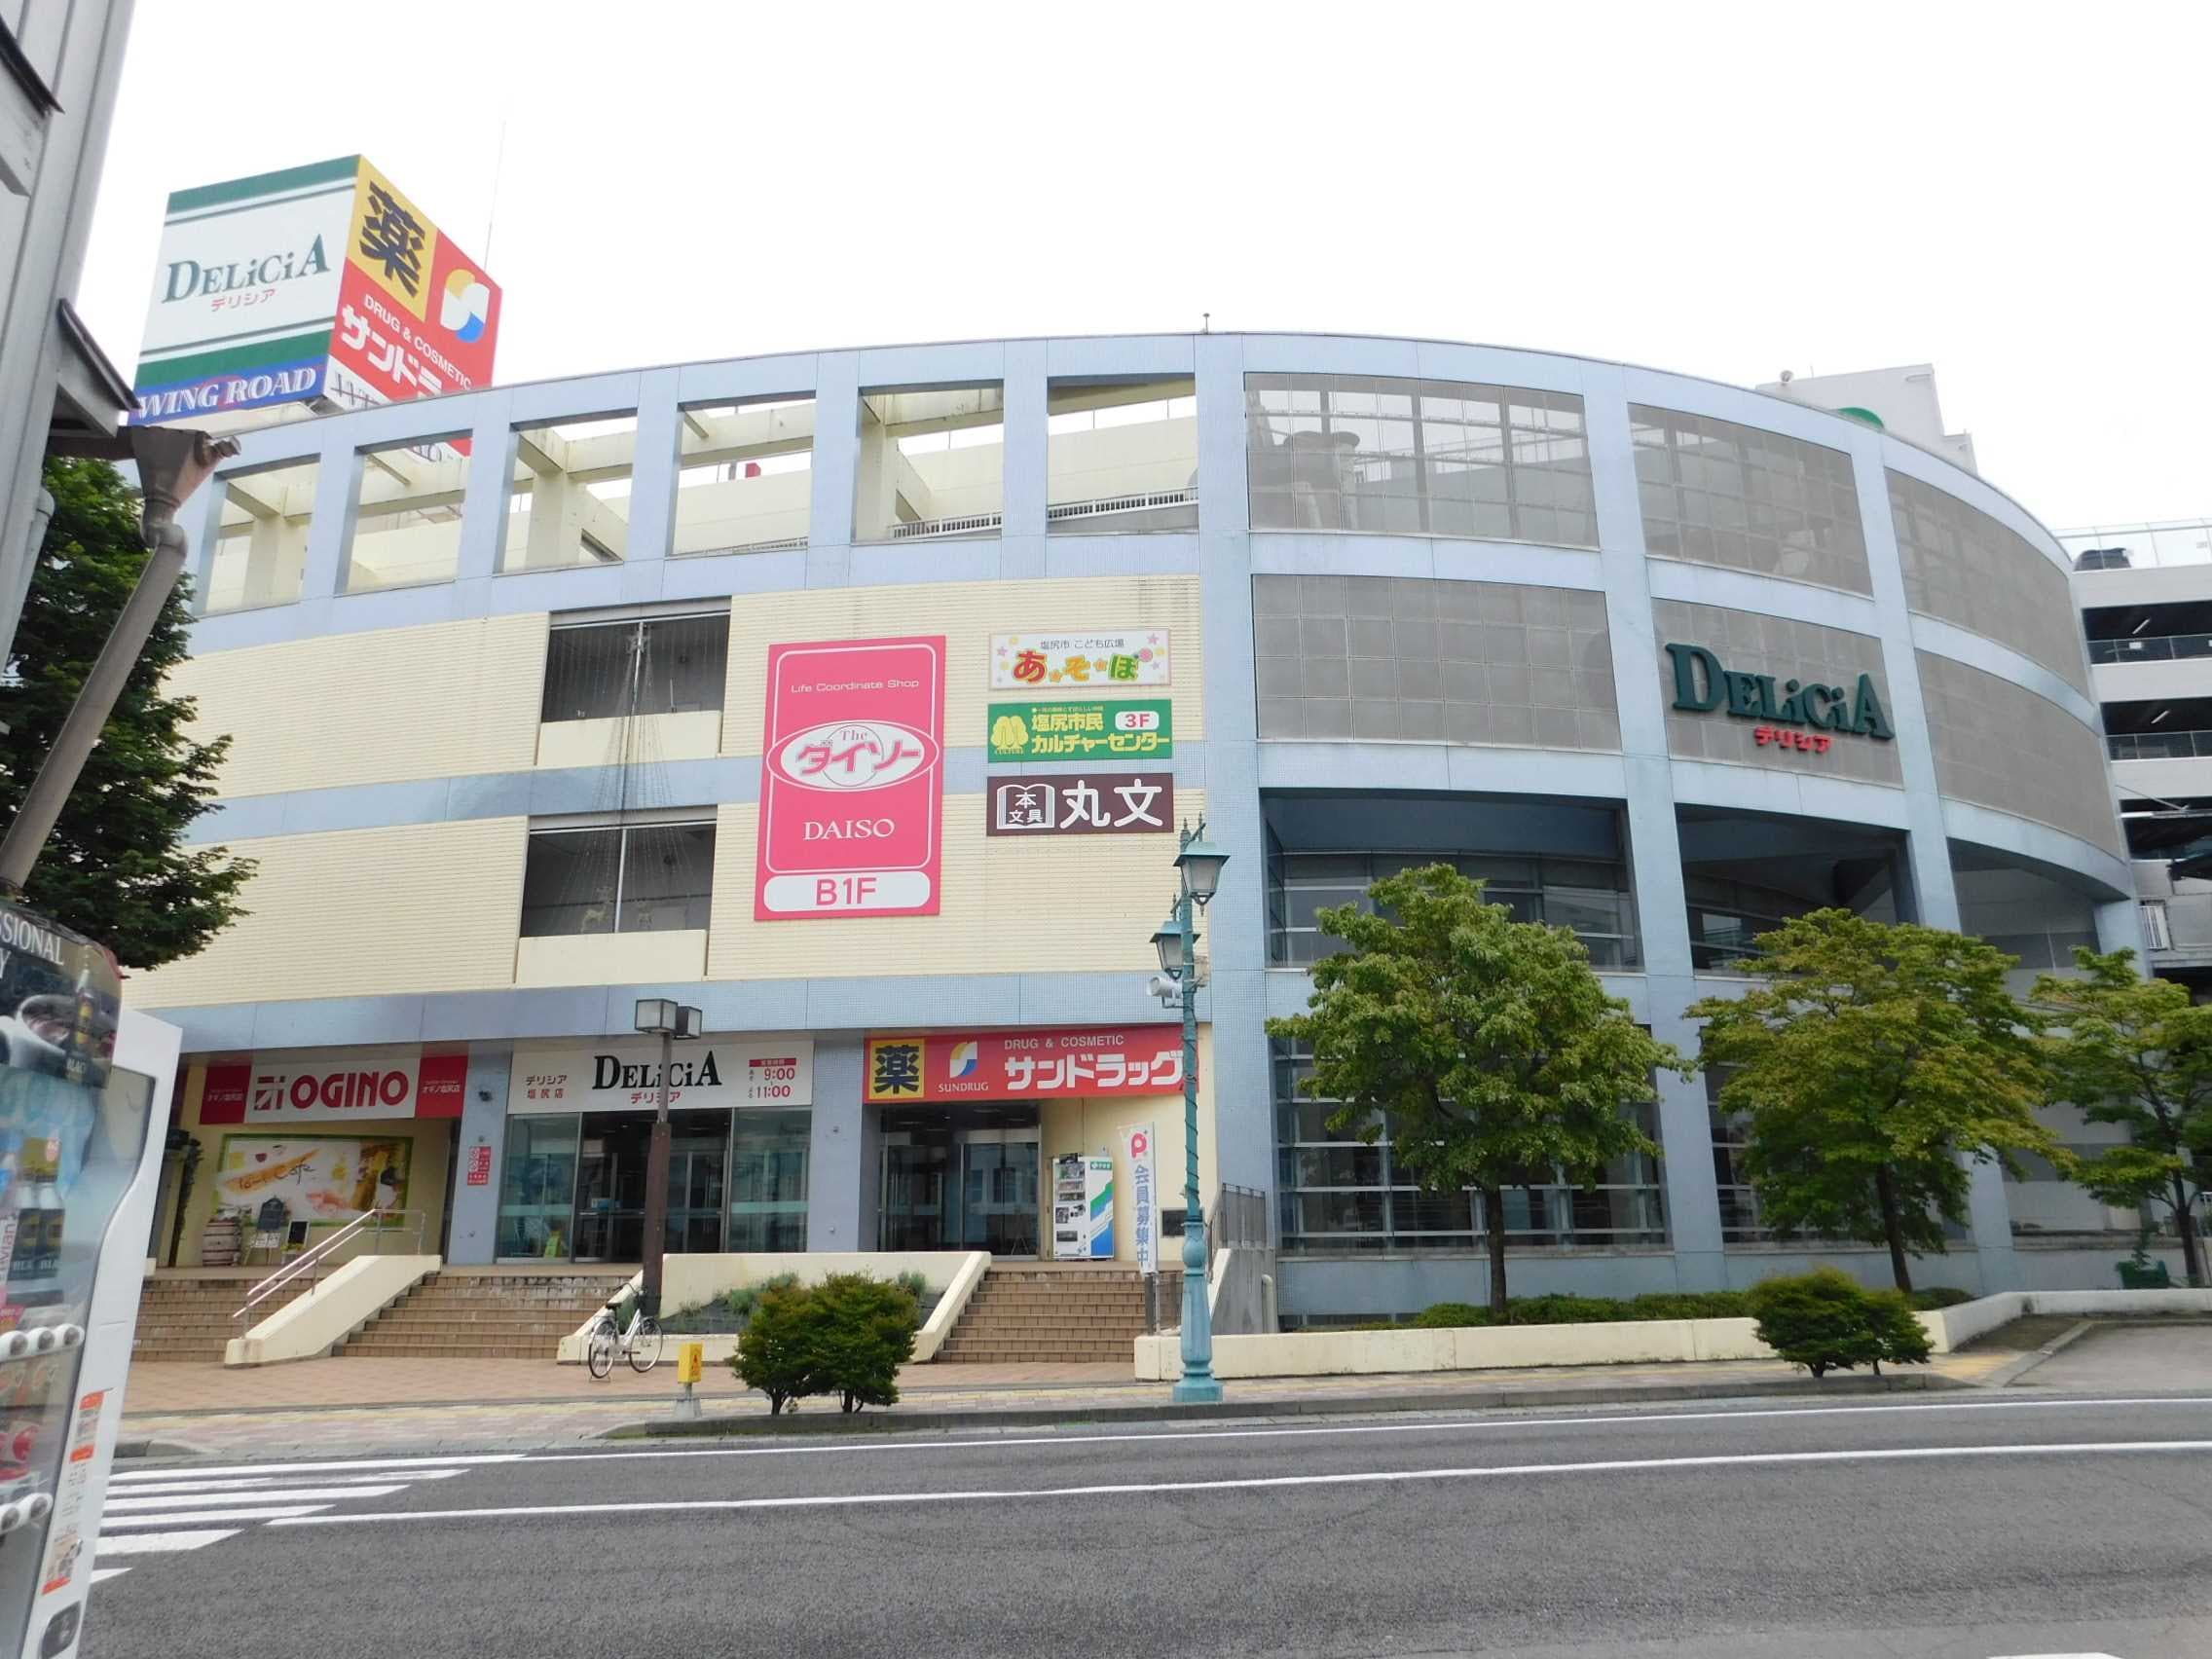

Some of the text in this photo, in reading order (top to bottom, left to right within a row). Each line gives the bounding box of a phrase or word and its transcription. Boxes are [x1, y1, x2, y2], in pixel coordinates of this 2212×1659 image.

[359, 180, 425, 299] 薬
[210, 288, 276, 312] デリシア
[364, 294, 401, 333] DRUG
[402, 327, 413, 343] &
[414, 336, 472, 390] COSMETIC
[225, 366, 317, 405] ROAD
[791, 679, 919, 693] Life Coordinate Shop
[1031, 713, 1104, 732] 塩尻市民
[1124, 714, 1151, 728] 3F
[839, 729, 867, 741] The
[1031, 731, 1170, 755] カルチャーセンター
[1754, 725, 1832, 754] デリシア
[796, 740, 920, 776] ダイソー
[1014, 792, 1037, 809] 本
[1059, 778, 1163, 830] 丸文
[1009, 809, 1043, 824] 文具
[802, 818, 895, 841] DAISO
[815, 876, 877, 905] B1F
[0, 910, 64, 966] SIONAL
[1005, 1035, 1124, 1051] DRUG & COSMETIC
[526, 1075, 567, 1086] デリシア
[764, 1067, 795, 1081] 9:00
[874, 1044, 920, 1094] 薬
[1005, 1050, 1184, 1090] サンドラッグ
[290, 1071, 409, 1110] OGINO
[756, 1085, 791, 1098] 11:00
[938, 1082, 988, 1092] SUNDRUG
